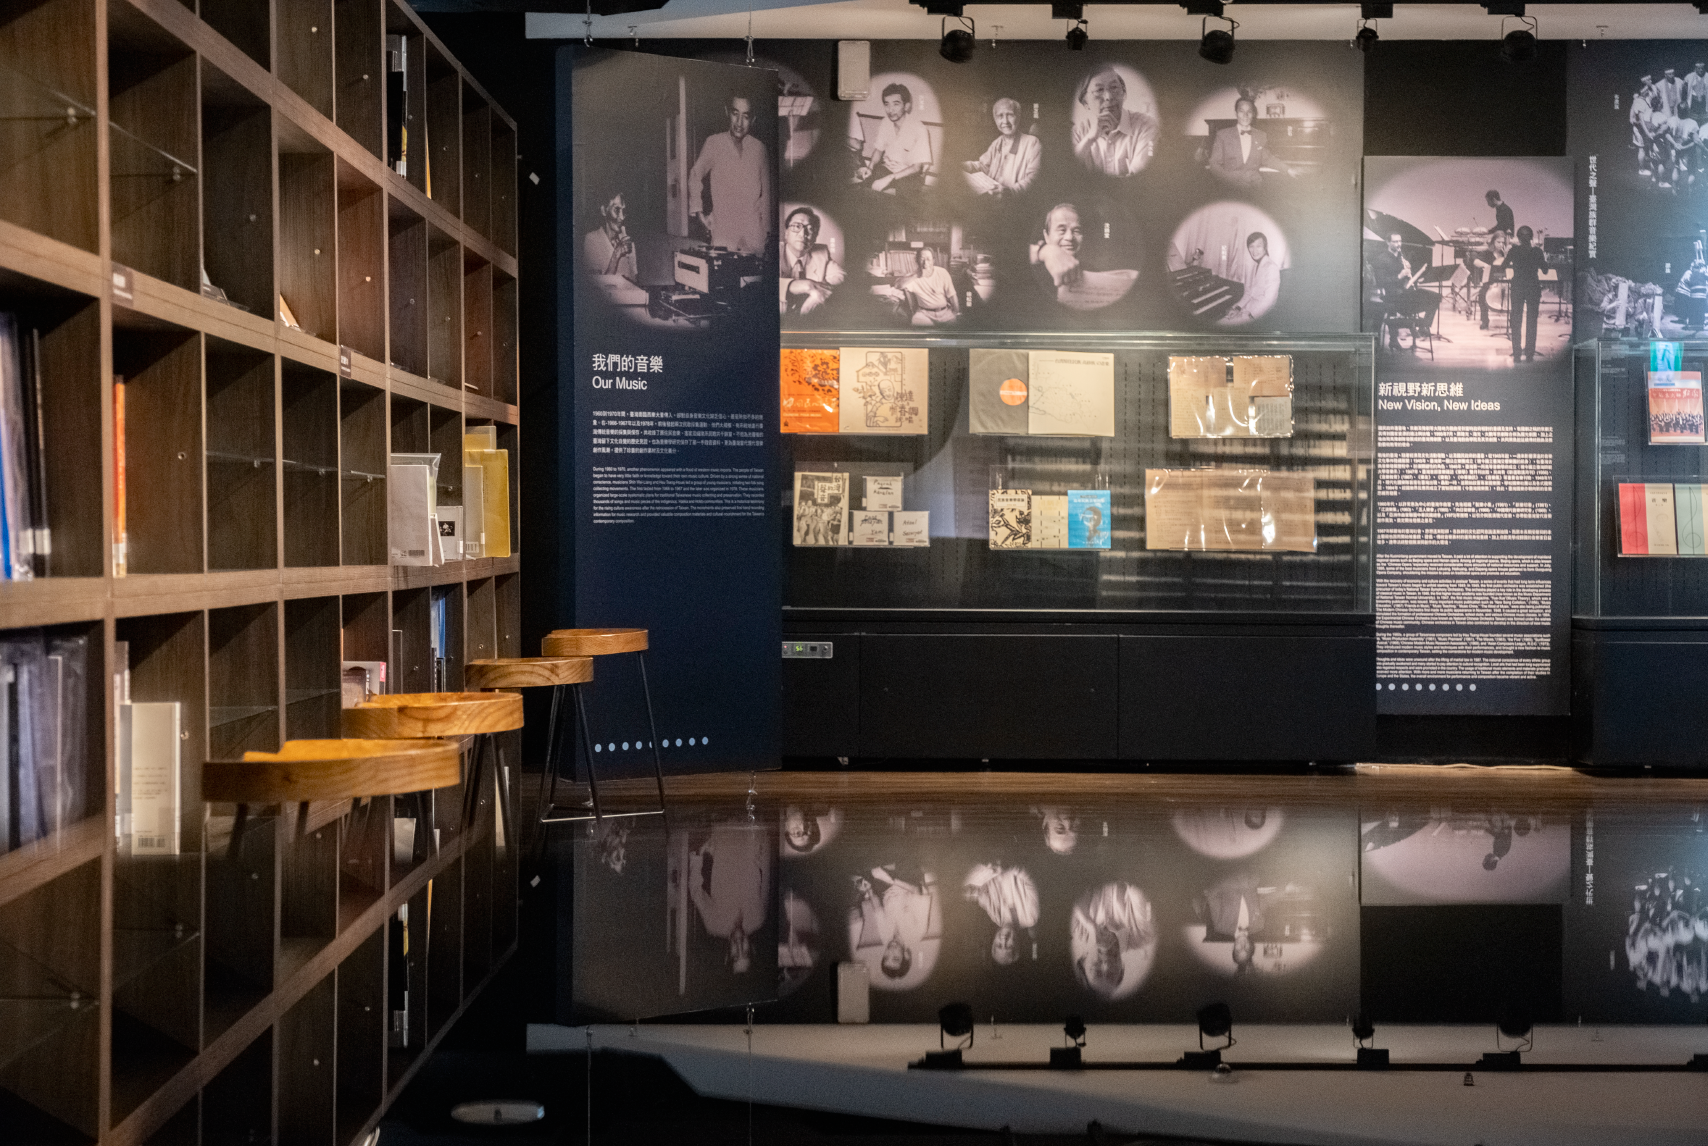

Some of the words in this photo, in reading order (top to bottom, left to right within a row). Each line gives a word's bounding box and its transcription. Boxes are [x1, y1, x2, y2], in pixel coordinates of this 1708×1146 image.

[592, 354, 663, 373] 我們的音樂
[592, 376, 612, 389] Our
[616, 377, 648, 390] Music
[1378, 382, 1464, 397] 新視野新思維
[1378, 400, 1402, 410] New
[1405, 400, 1441, 412] Vision,
[1444, 400, 1468, 411] New
[1471, 400, 1500, 411] Ideas
